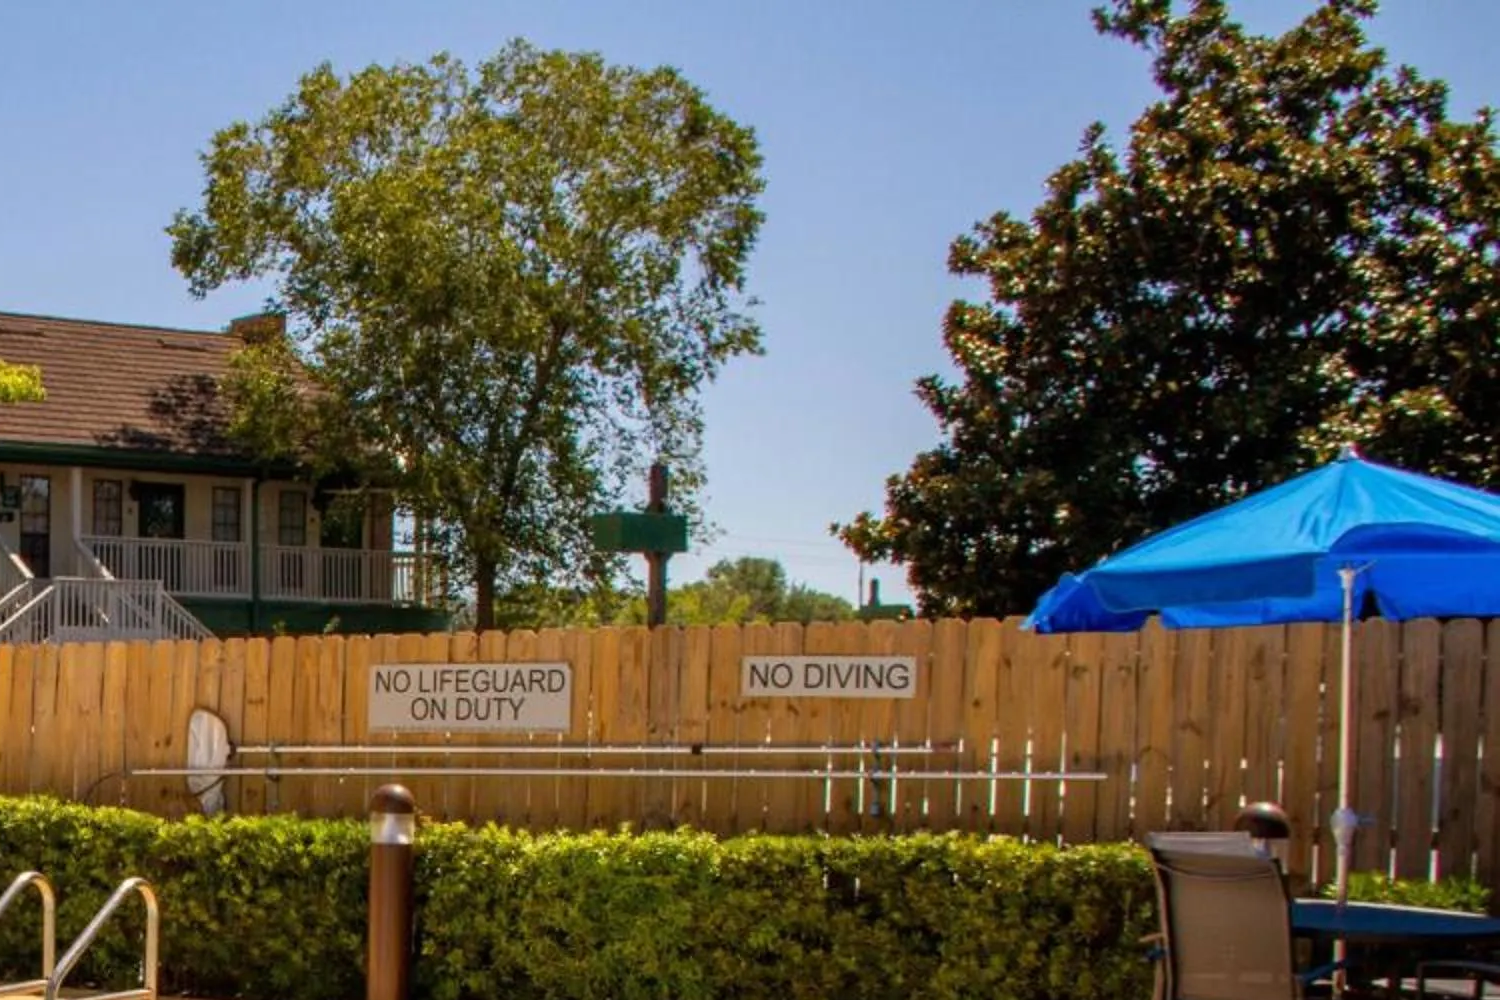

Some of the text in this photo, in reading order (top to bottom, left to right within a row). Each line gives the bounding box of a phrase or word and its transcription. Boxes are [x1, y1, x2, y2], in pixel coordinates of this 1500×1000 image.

[375, 669, 566, 693] NO LIFEGUARD
[749, 663, 910, 689] NO DIVING
[410, 697, 525, 721] ON DUTY
